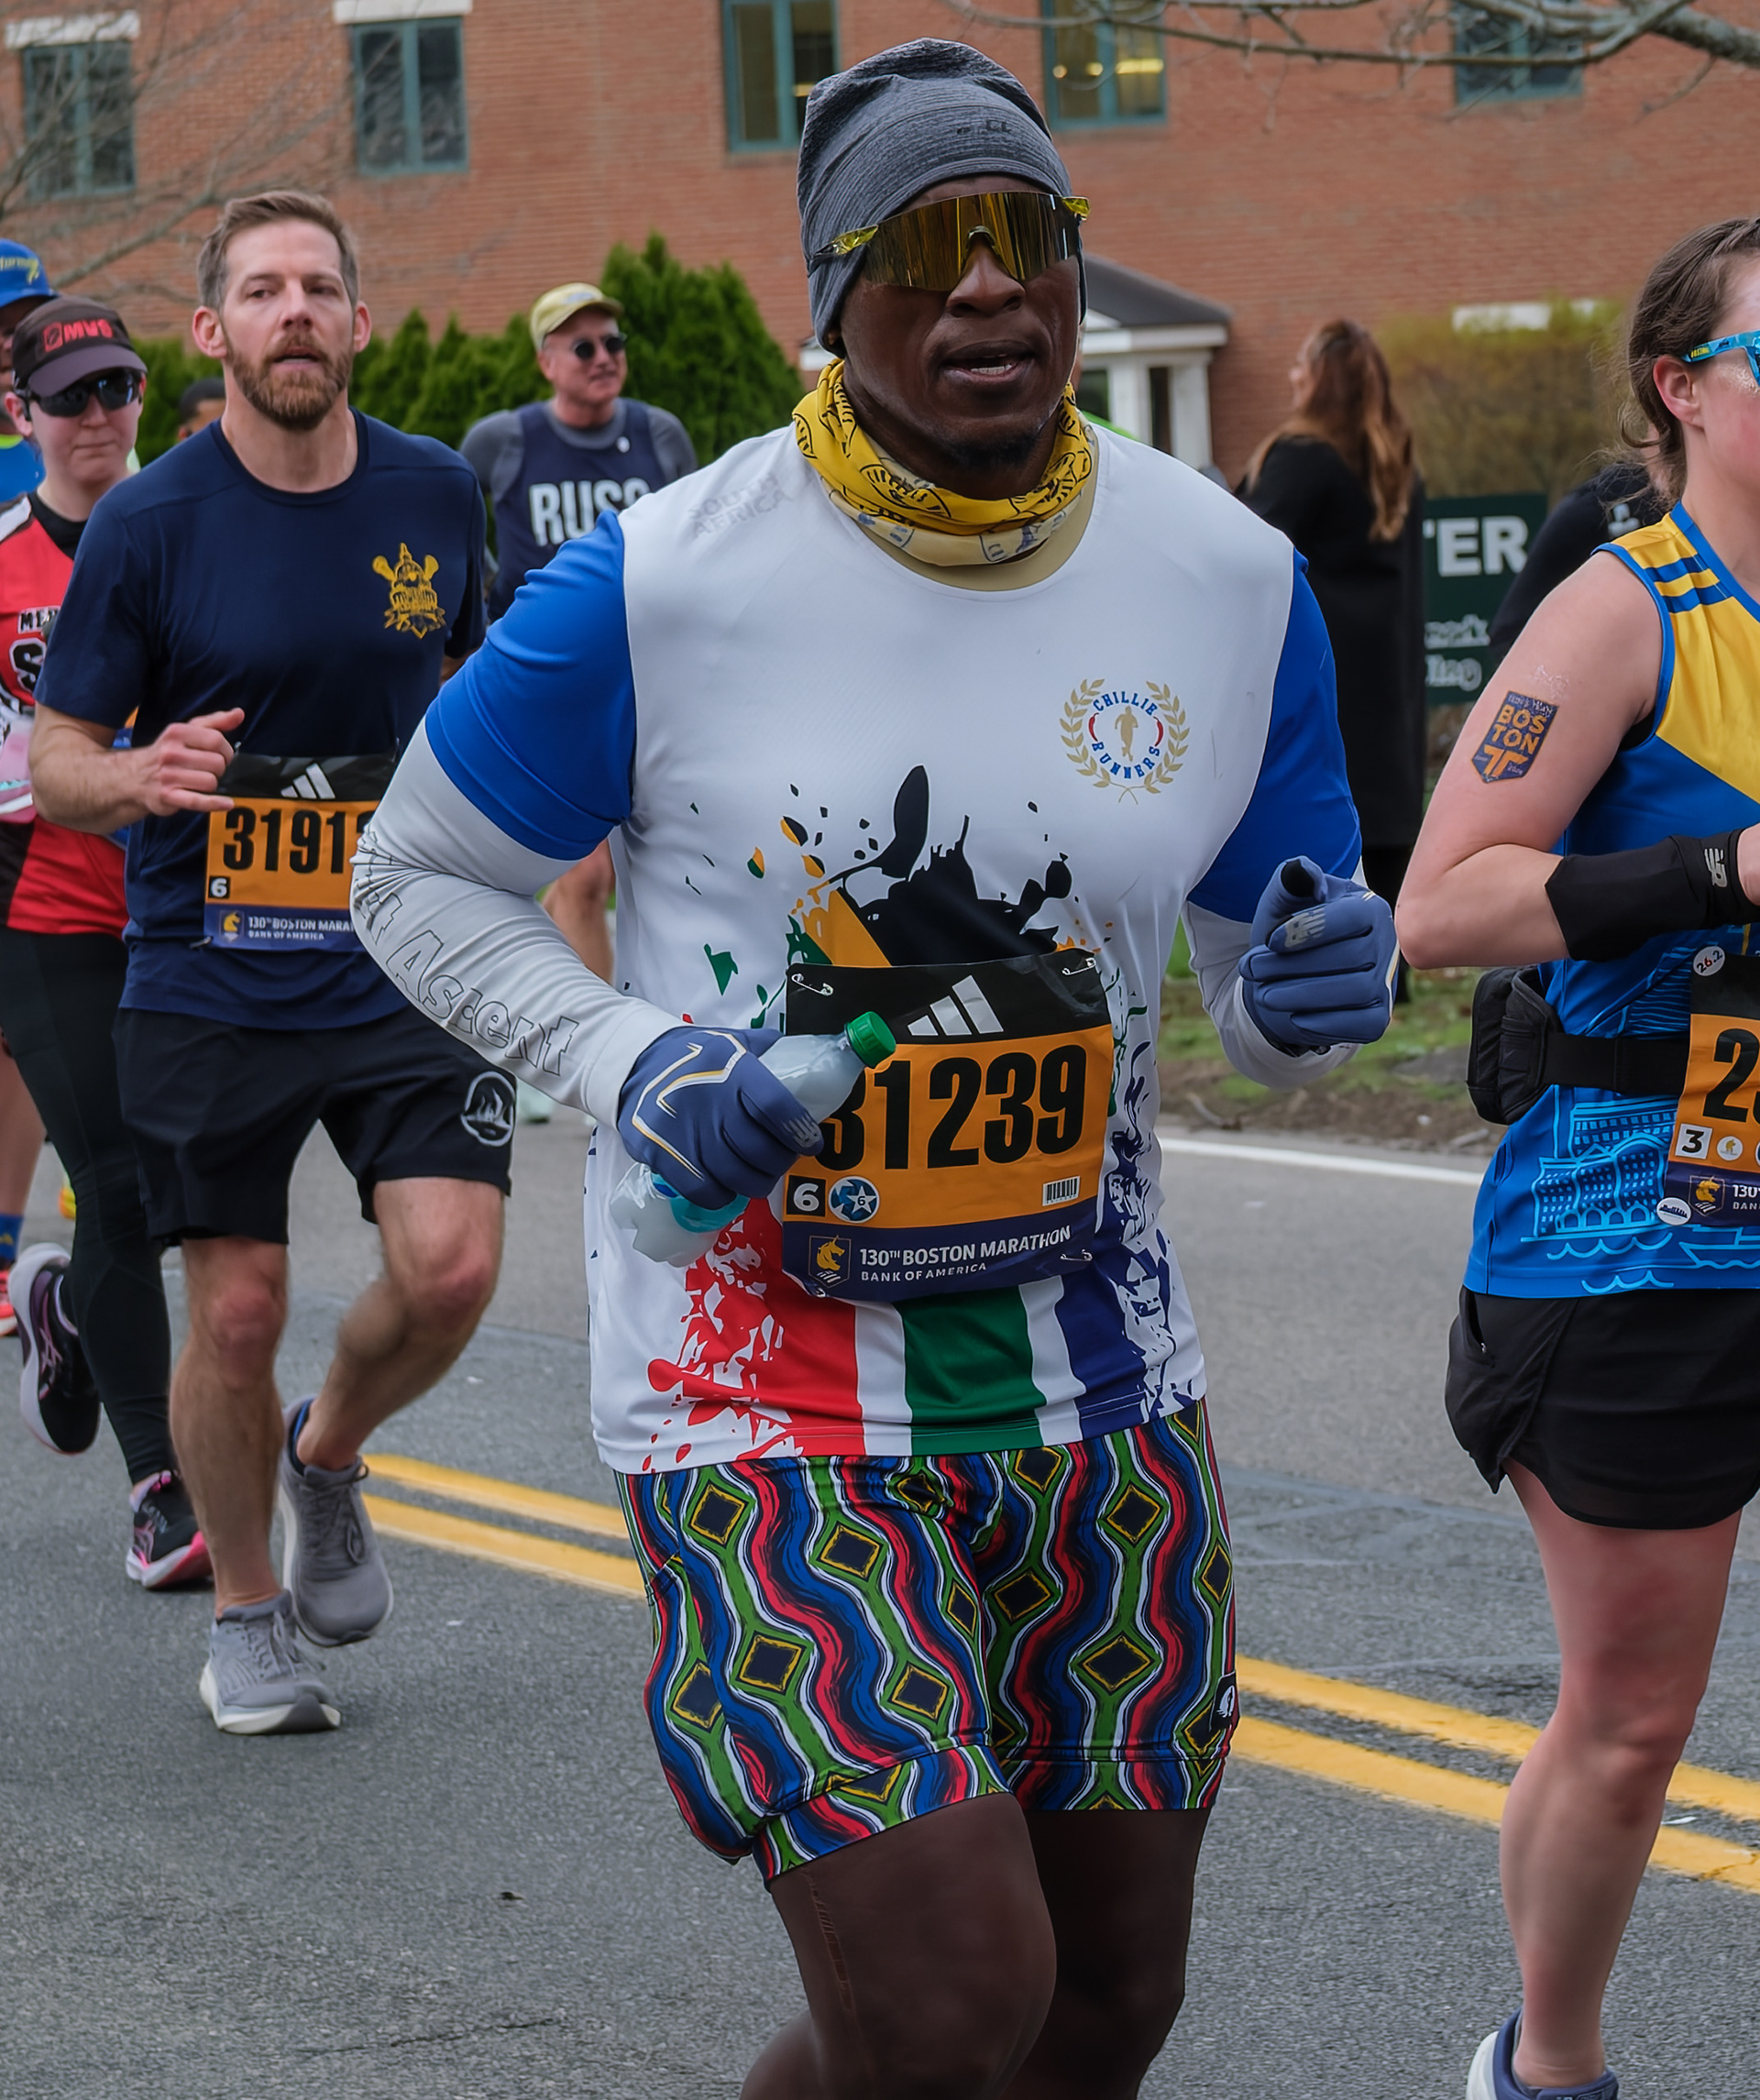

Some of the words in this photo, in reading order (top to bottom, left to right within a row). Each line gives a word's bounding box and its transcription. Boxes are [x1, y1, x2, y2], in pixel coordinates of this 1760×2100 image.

[1423, 515, 1528, 577] ER
[1093, 690, 1158, 716] CHILLIE
[1091, 742, 1160, 779] RUNNERS
[223, 807, 378, 874] 3191
[211, 877, 227, 897] 6
[272, 918, 316, 930] BOSTON
[286, 932, 325, 940] AMERICA
[1696, 950, 1723, 973] 26.2
[386, 929, 579, 1077] Ascent
[1702, 1028, 1760, 1125] 2
[814, 1043, 1088, 1172] 31239
[1681, 1128, 1705, 1154] 3
[793, 1182, 820, 1212] 6
[856, 1195, 866, 1206] 6
[1732, 1183, 1760, 1198] 130
[1732, 1201, 1760, 1210] BAN
[859, 1248, 900, 1267] 130TH
[902, 1243, 975, 1266] BOSTON
[979, 1225, 1072, 1258] MARATHON
[861, 1270, 901, 1282] BANK
[904, 1270, 923, 1281] OF
[925, 1261, 987, 1280] AMERICA
